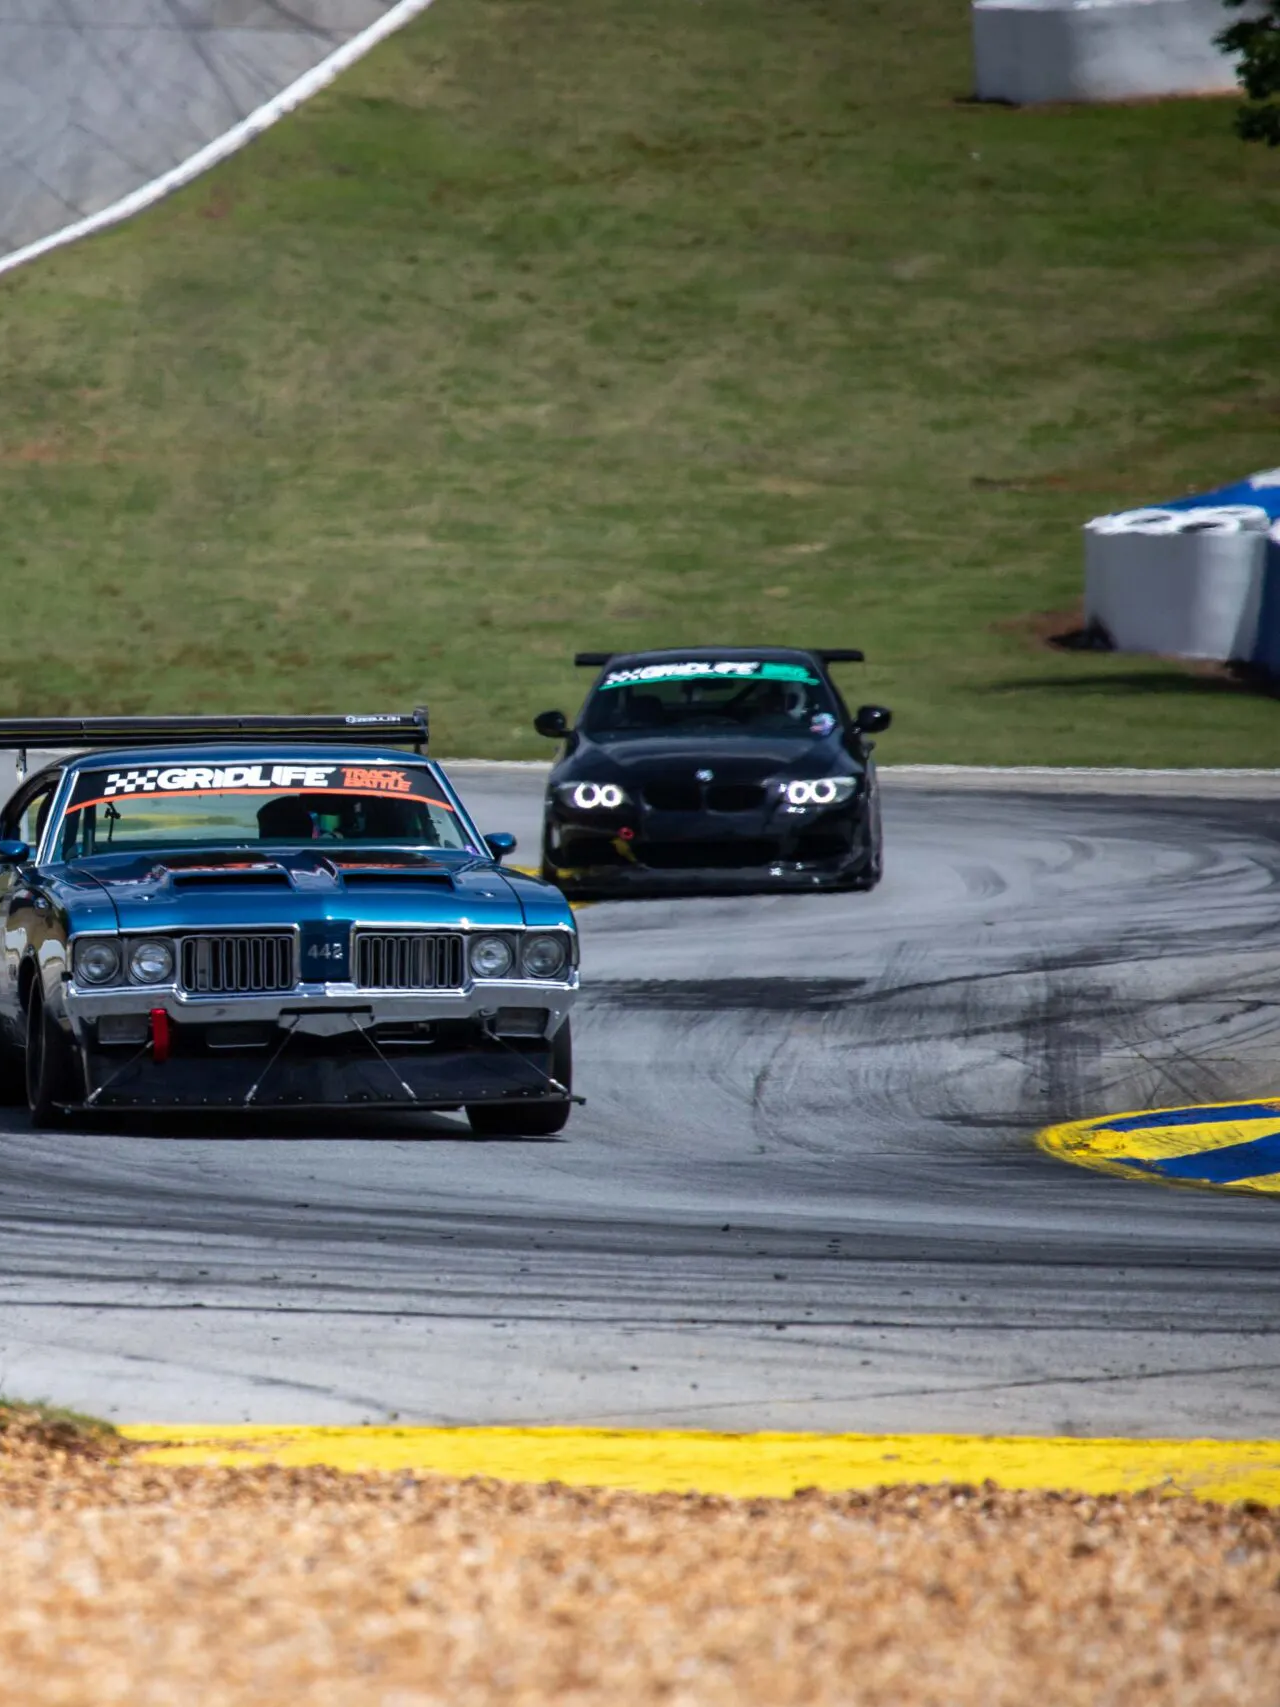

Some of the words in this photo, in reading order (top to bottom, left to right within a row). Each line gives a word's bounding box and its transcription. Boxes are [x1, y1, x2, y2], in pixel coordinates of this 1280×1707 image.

[157, 766, 336, 788] GRIDLIFE
[341, 767, 407, 781] TRACK
[344, 778, 412, 791] BATTLE
[307, 943, 343, 959] 442
